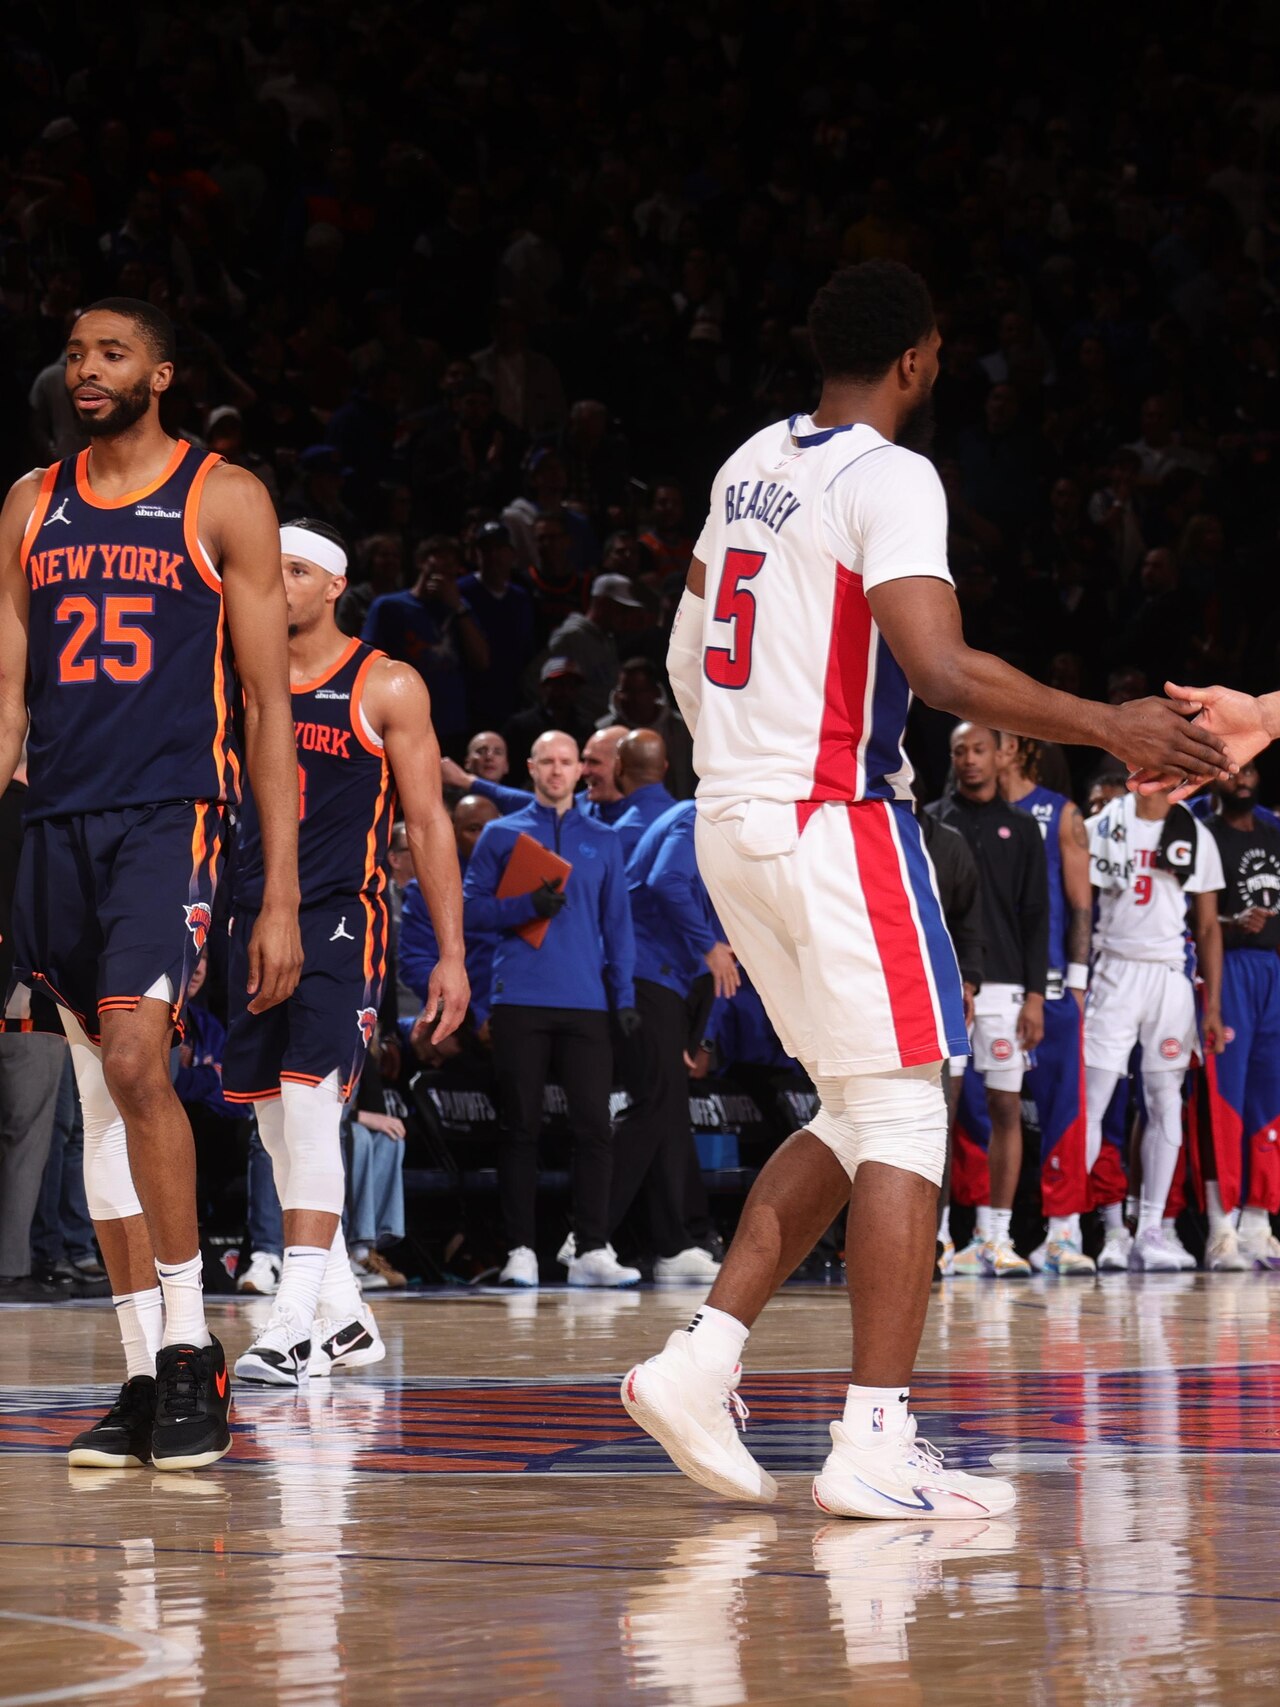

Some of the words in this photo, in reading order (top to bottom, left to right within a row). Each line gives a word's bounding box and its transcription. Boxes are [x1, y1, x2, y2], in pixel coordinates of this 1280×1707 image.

[135, 508, 153, 517] abu
[726, 481, 800, 533] BEASLEY
[30, 546, 96, 590] NEW
[100, 545, 184, 591] YORK
[55, 594, 155, 685] 25
[704, 547, 766, 690] 5
[1134, 875, 1152, 906] 9
